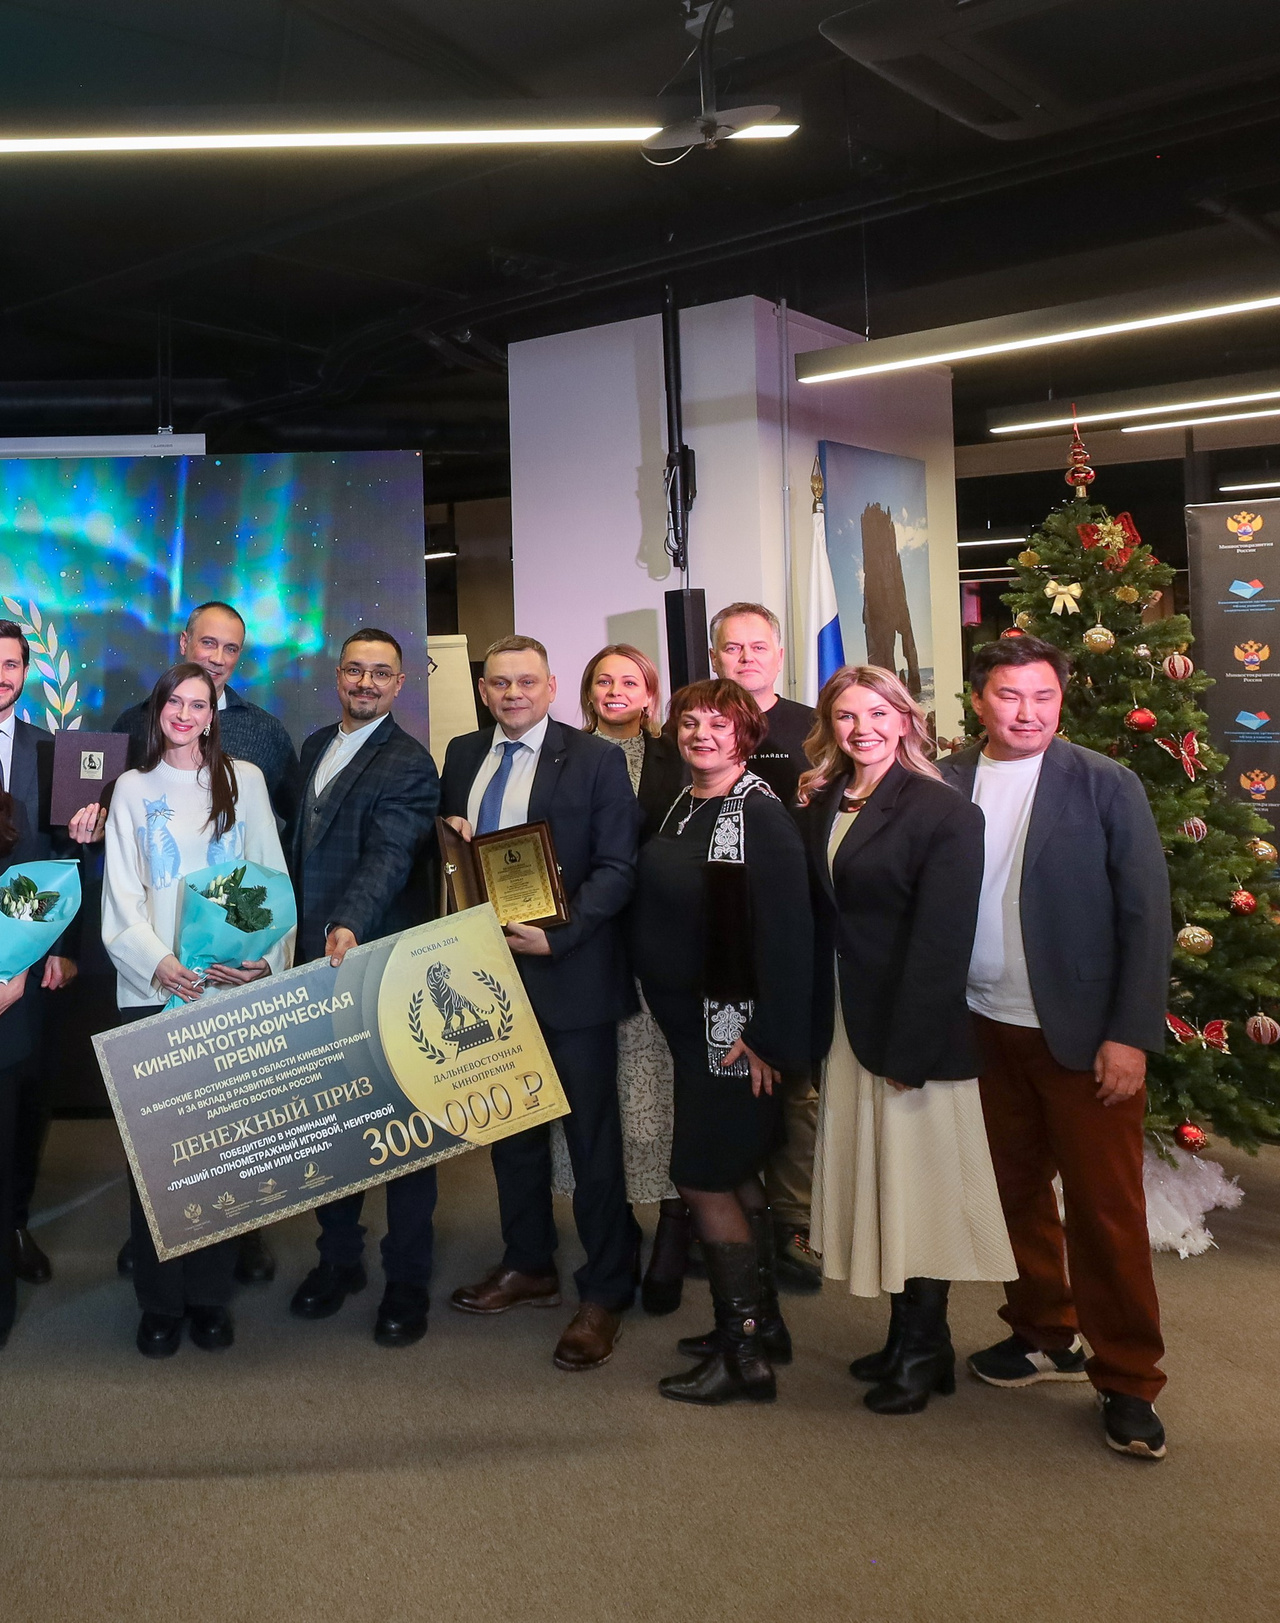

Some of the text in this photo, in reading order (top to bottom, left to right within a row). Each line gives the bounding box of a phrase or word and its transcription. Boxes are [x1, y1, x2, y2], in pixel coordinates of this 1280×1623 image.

[410, 936, 459, 957] МОСКВА 2024
[132, 991, 355, 1080] КИНЕМАТОГРАФИЧЕСКАЯ
[166, 986, 309, 1047] НАЦИОНАЛЬНАЯ
[140, 1030, 372, 1116] ЗА ВЫСОКИЕ ДОСТИЖЕНИЯ В ОБЛАСТИ КИНЕМАТОГРАФИИ
[213, 1034, 288, 1073] ПРЕМИЯ
[433, 1044, 523, 1084] ДАЛЬНЕВОСТОЧНАЯ
[451, 1061, 516, 1091] КИНОПРЕМИЯ
[177, 1052, 345, 1116] И ЗА ВКЛАД В РАЗВИТИЕ КИНОИНДУСТРИИ
[207, 1072, 322, 1120] ДАЛЬНЕГО ВОСТОКА РОССИИ
[167, 1103, 395, 1191] «ЛУЧШИЙ ПОЛНОМЕТРАЖНЫЙ ИГРОВОЙ, НЕИГРОВОЙ
[171, 1076, 374, 1167] ДЕНЕЖНЫЙ ПРИЗ
[219, 1113, 337, 1161] ПОБЕДИТЕЛЮ В НОМИНАЦИИ
[362, 1111, 435, 1166] 300
[442, 1082, 513, 1136] 000
[239, 1140, 333, 1179] ФИЛЬМ ИЛИ СЕРИАЛ»
